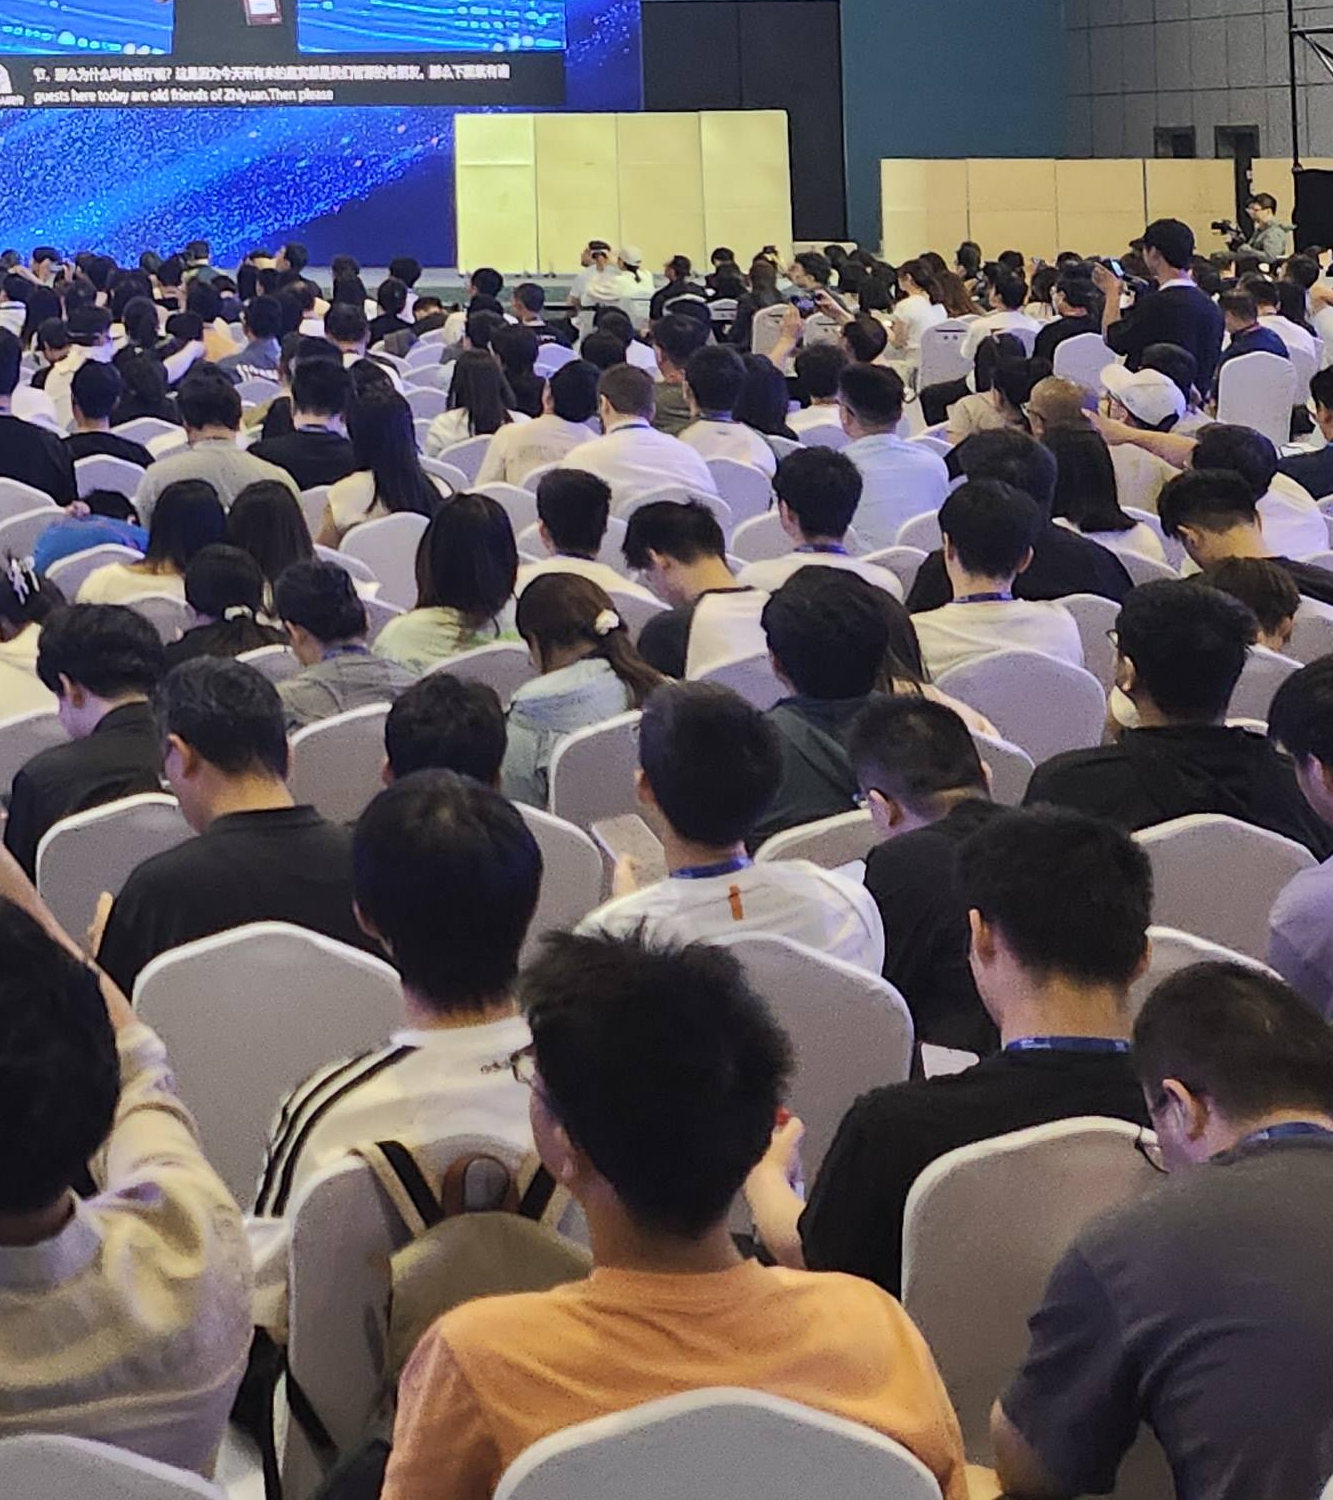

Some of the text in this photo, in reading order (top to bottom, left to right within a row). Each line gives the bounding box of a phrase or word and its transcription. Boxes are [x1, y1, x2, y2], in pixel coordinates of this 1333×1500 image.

[33, 91, 70, 105] guests
[71, 89, 96, 102] here
[98, 88, 129, 103] today
[131, 91, 149, 102] are
[150, 88, 170, 102] old
[171, 88, 208, 102] friends
[210, 88, 222, 101] of
[298, 88, 334, 103] please
